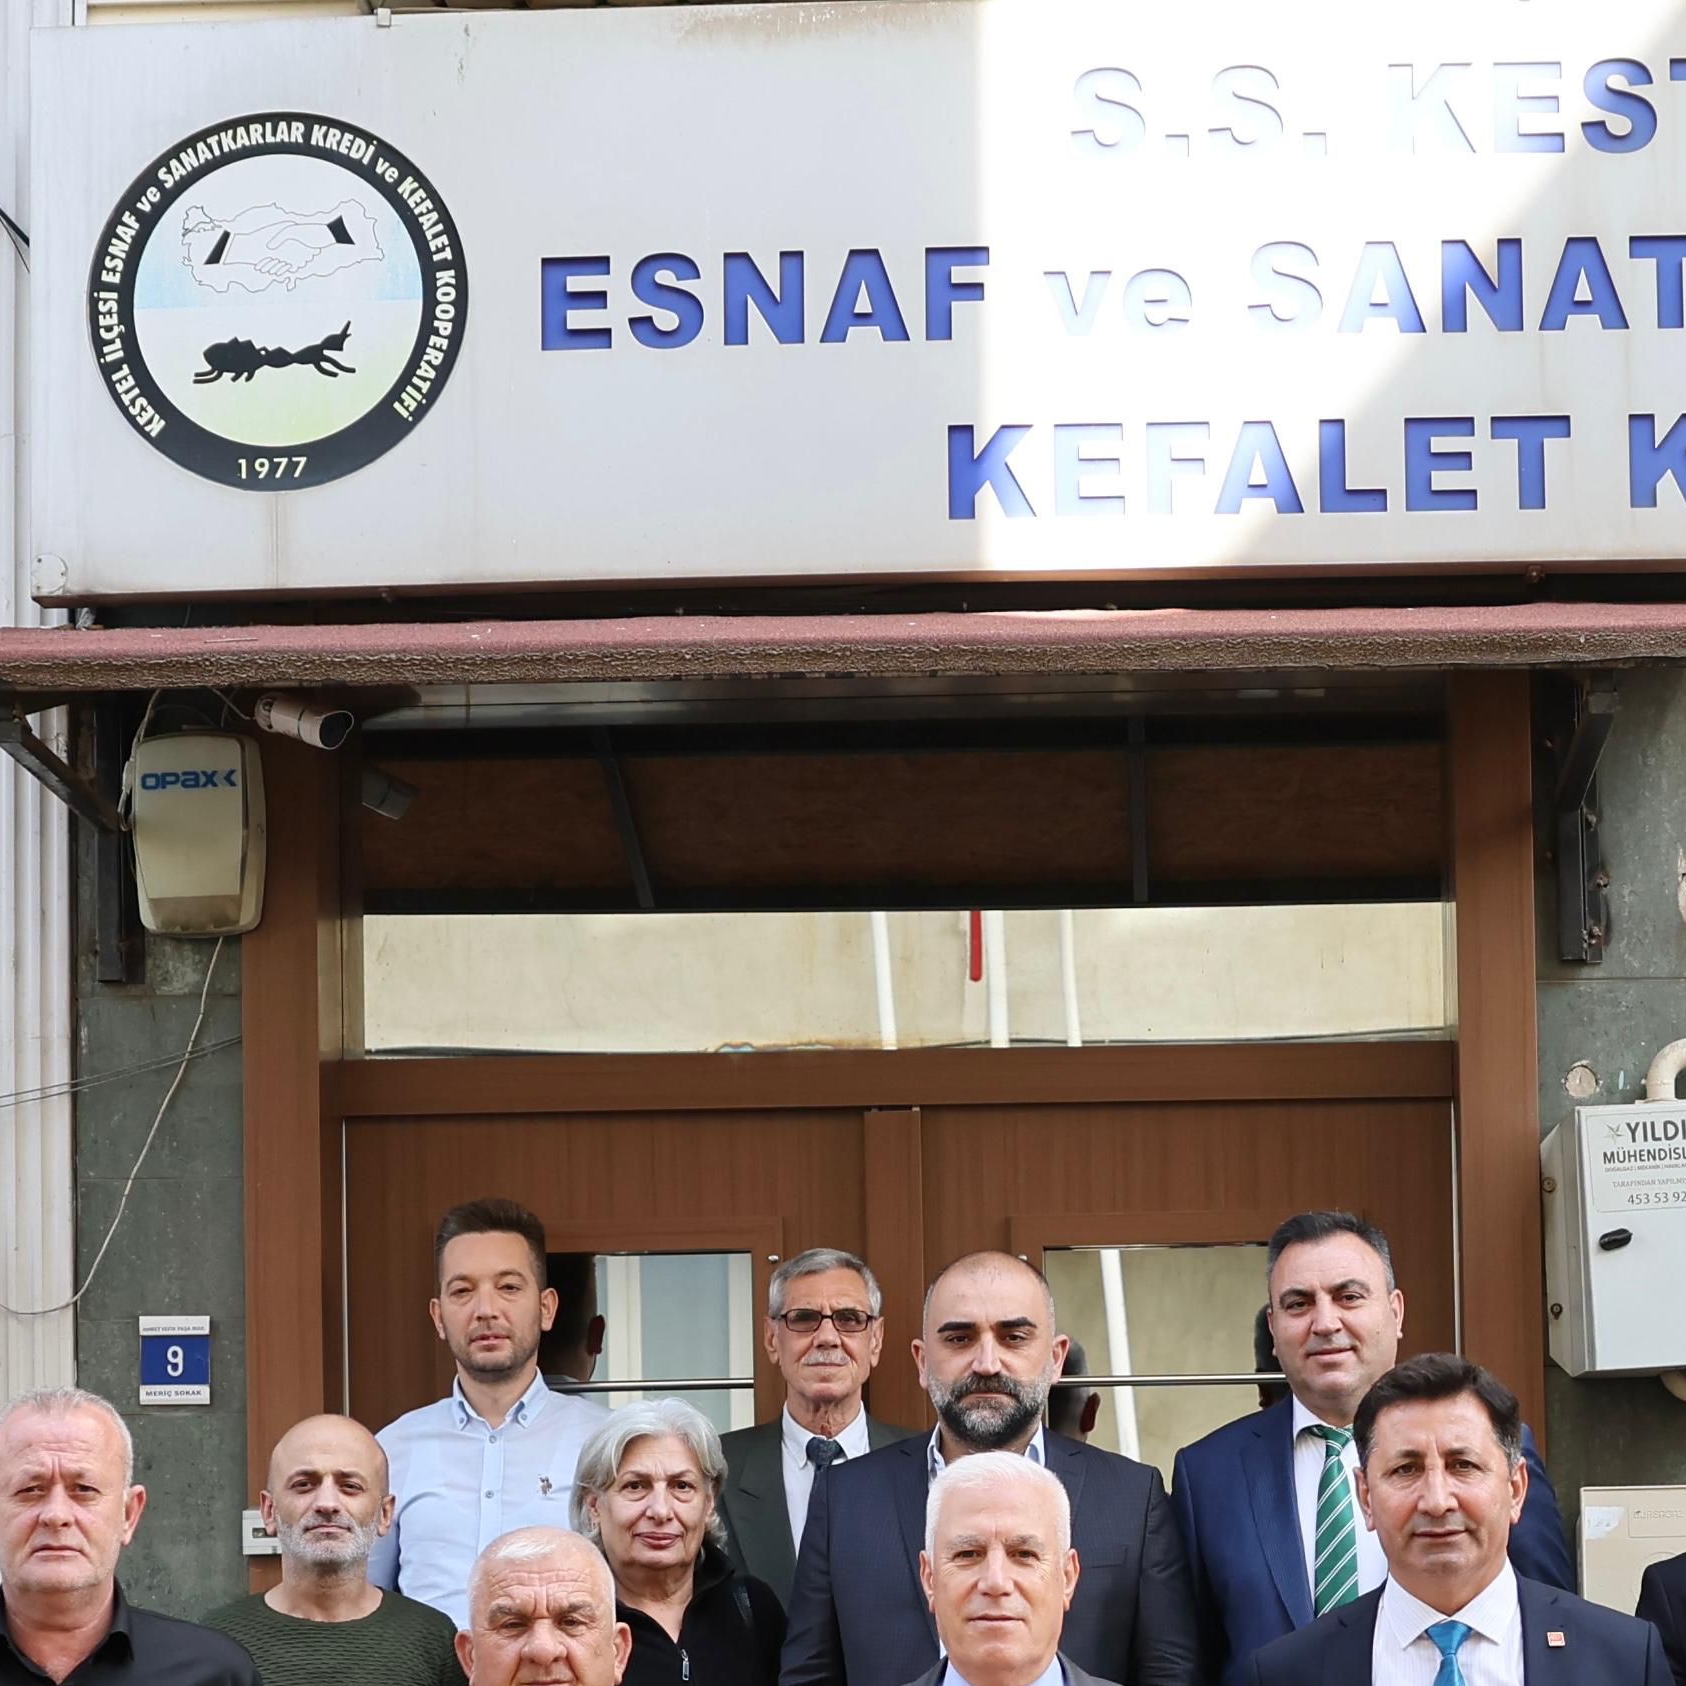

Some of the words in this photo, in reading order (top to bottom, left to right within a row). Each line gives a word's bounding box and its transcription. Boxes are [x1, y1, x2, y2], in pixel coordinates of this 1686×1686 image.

[311, 125, 377, 164] KREDİ
[1070, 65, 1328, 158] S.S.
[159, 121, 304, 187] SANATKARLAR
[374, 157, 398, 183] ve
[136, 185, 162, 214] ve
[397, 176, 453, 261] KEFALET
[103, 211, 139, 284] ESNAF
[94, 292, 126, 363] İLÇESİ
[541, 246, 990, 351] ESNAF
[1043, 268, 1194, 338] ve
[393, 270, 456, 422] KOOPERATİFİ
[111, 363, 165, 437] KESTEL
[237, 456, 307, 480] 1977
[948, 413, 1572, 520] KEFALET
[1613, 1180, 1656, 1188] TARAFINDAN
[1627, 1194, 1650, 1205] 453
[1654, 1192, 1669, 1204] 53
[167, 1346, 184, 1377] 9
